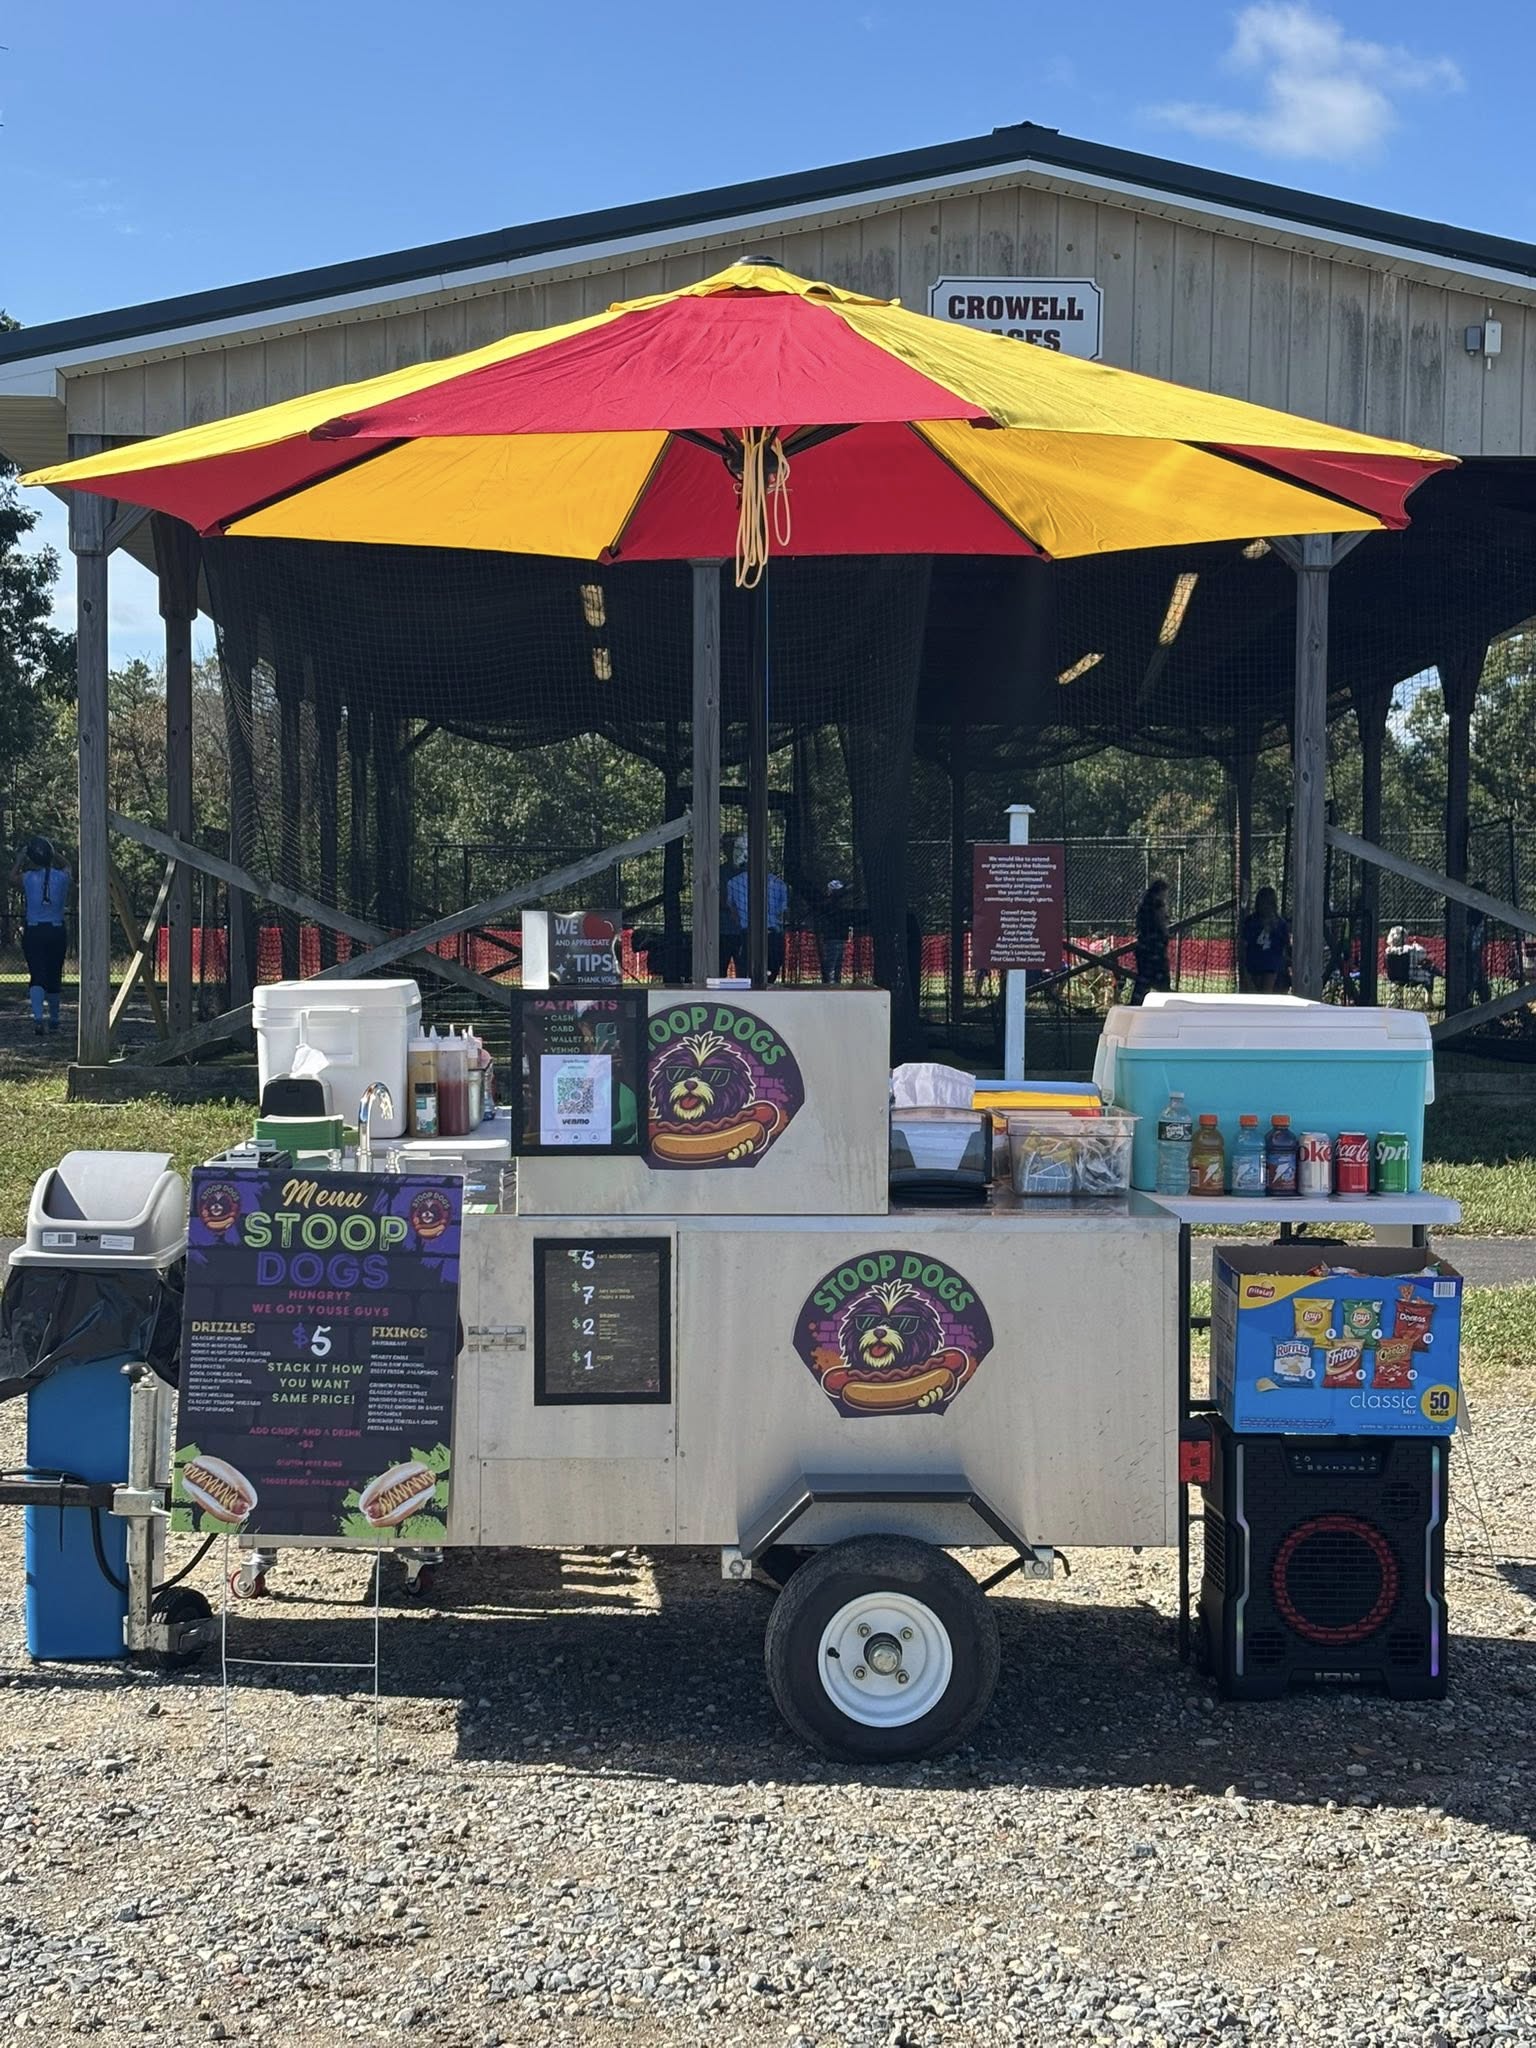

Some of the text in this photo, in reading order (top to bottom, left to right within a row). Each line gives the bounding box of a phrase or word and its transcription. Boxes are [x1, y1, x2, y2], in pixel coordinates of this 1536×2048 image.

[948, 296, 1084, 320] CROWELL
[555, 920, 578, 934] WE
[648, 1006, 786, 1066] OOP DOGS
[282, 1178, 368, 1210] Menu
[244, 1212, 408, 1251] STOOP
[571, 1250, 595, 1270] $5
[256, 1252, 390, 1289] DOGS
[572, 1281, 595, 1305] $7
[814, 1255, 974, 1314] STOOP DOGS
[288, 1290, 351, 1300] HUNGRY?
[252, 1304, 390, 1317] WE GOT YOUSE GUYS
[1400, 1313, 1426, 1322] Doritos
[192, 1321, 256, 1333] DRIZZLES
[372, 1327, 428, 1338] FIXINGS
[572, 1317, 594, 1335] $2
[292, 1322, 332, 1356] $5
[1276, 1344, 1309, 1356] RUFFLES
[1328, 1346, 1358, 1366] Fritos
[268, 1362, 311, 1372] STACK
[316, 1364, 328, 1373] IT
[332, 1364, 363, 1374] HOW
[572, 1350, 594, 1370] $1
[280, 1378, 350, 1389] YOU WANT
[272, 1393, 355, 1404] SAME PRICE!
[1350, 1392, 1416, 1409] classic
[1430, 1392, 1450, 1409] 50
[1314, 1672, 1360, 1682] ION
